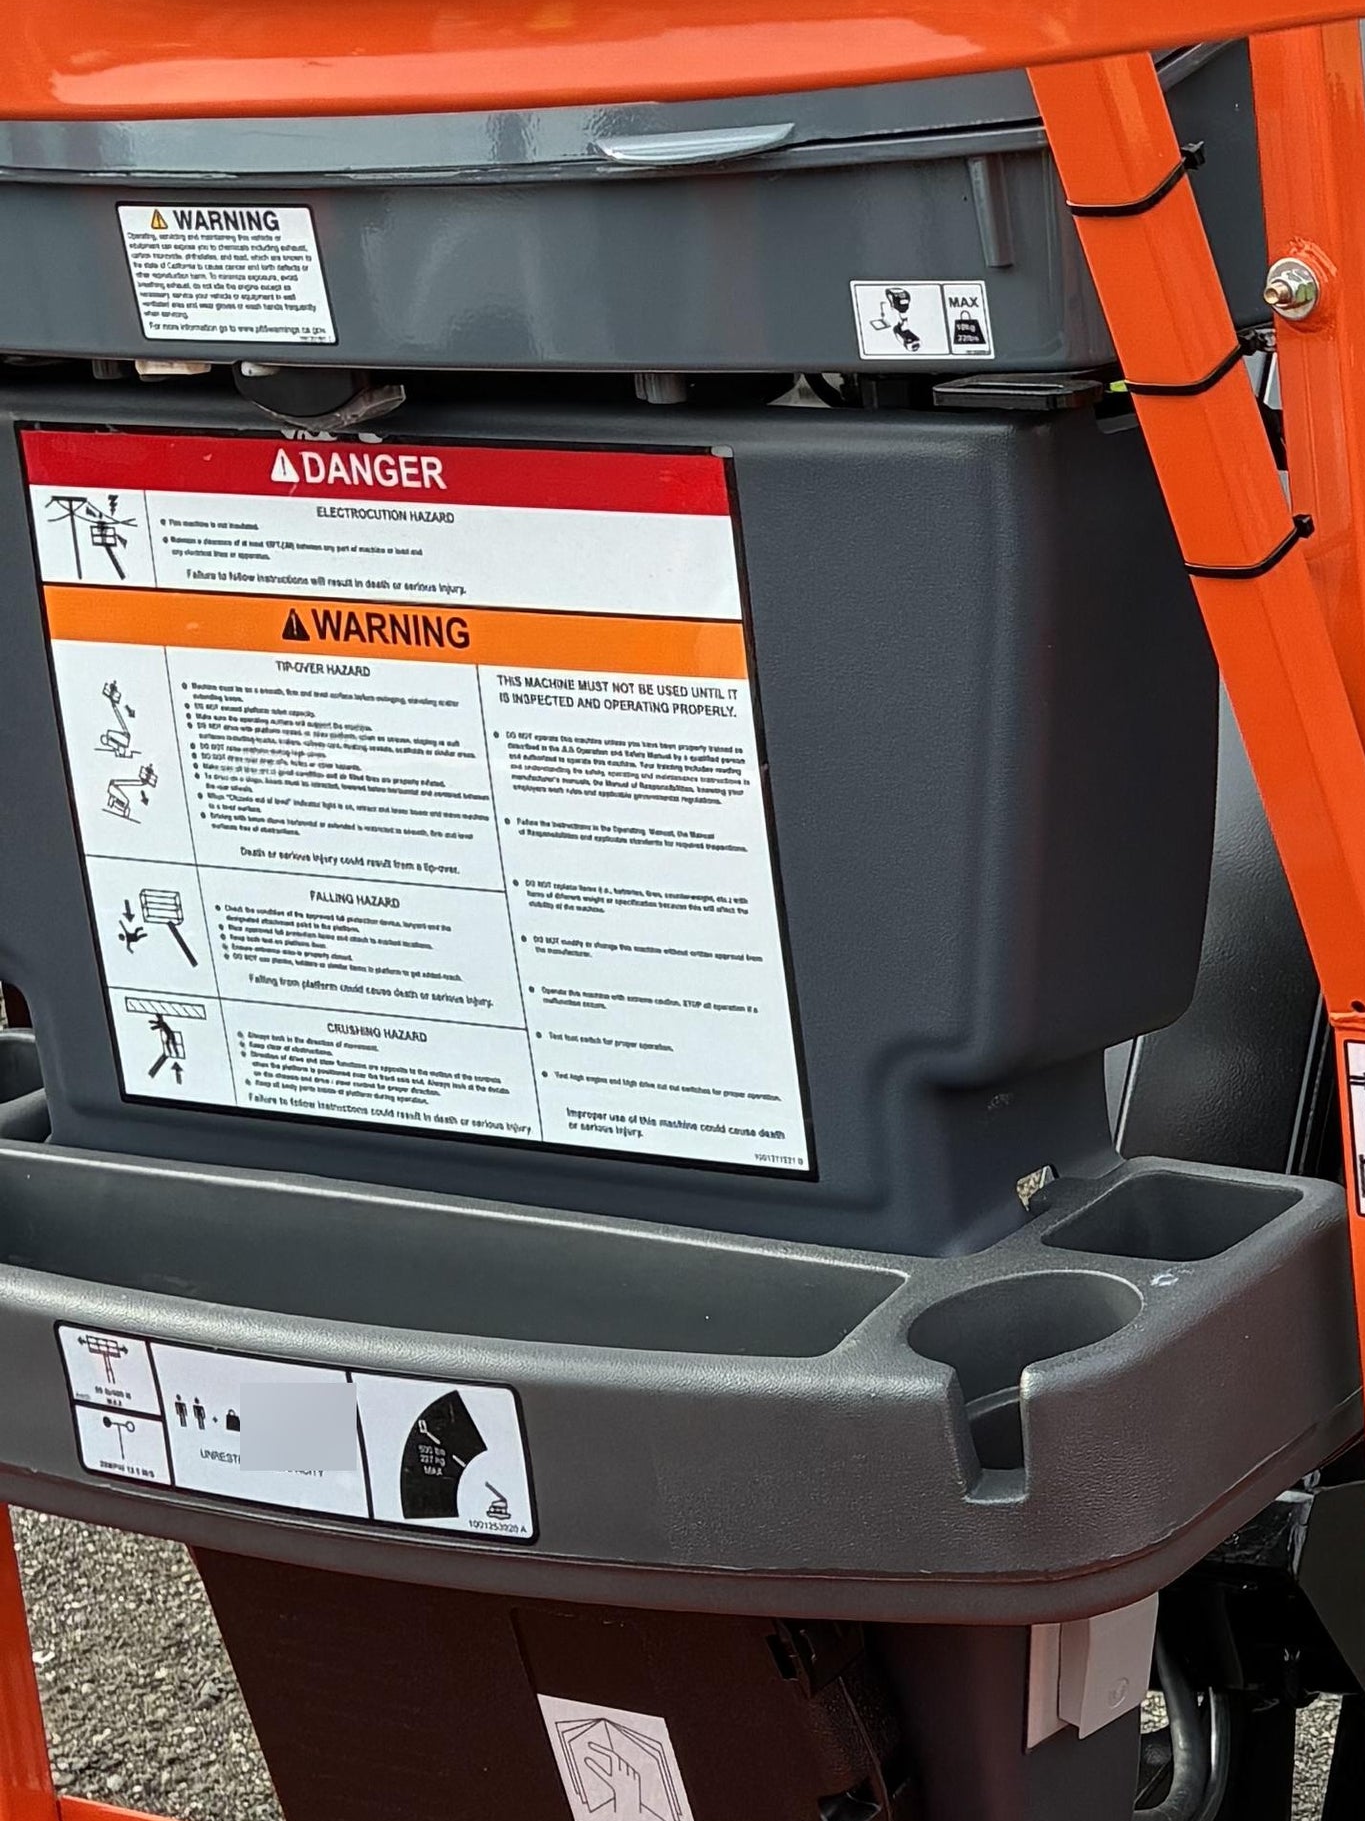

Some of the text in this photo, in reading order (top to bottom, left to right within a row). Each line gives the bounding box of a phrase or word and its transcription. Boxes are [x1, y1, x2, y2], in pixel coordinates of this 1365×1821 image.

[172, 209, 281, 231] WARNING
[949, 297, 979, 308] MAX
[301, 451, 448, 490] DANGER
[315, 505, 455, 524] ELECTROCUTION HAZARD
[309, 607, 472, 650] WARNING
[274, 660, 371, 677] TIP-OVER HAZARD
[496, 674, 739, 700] THIS MACHINE MUST NOT BE USED UNTIL IT
[498, 691, 737, 718] IS INSPECTED AND OPERATING PROPERLY.
[309, 889, 401, 909] FALLING HAZARD
[326, 1021, 428, 1043] CRUSHING HAZARD
